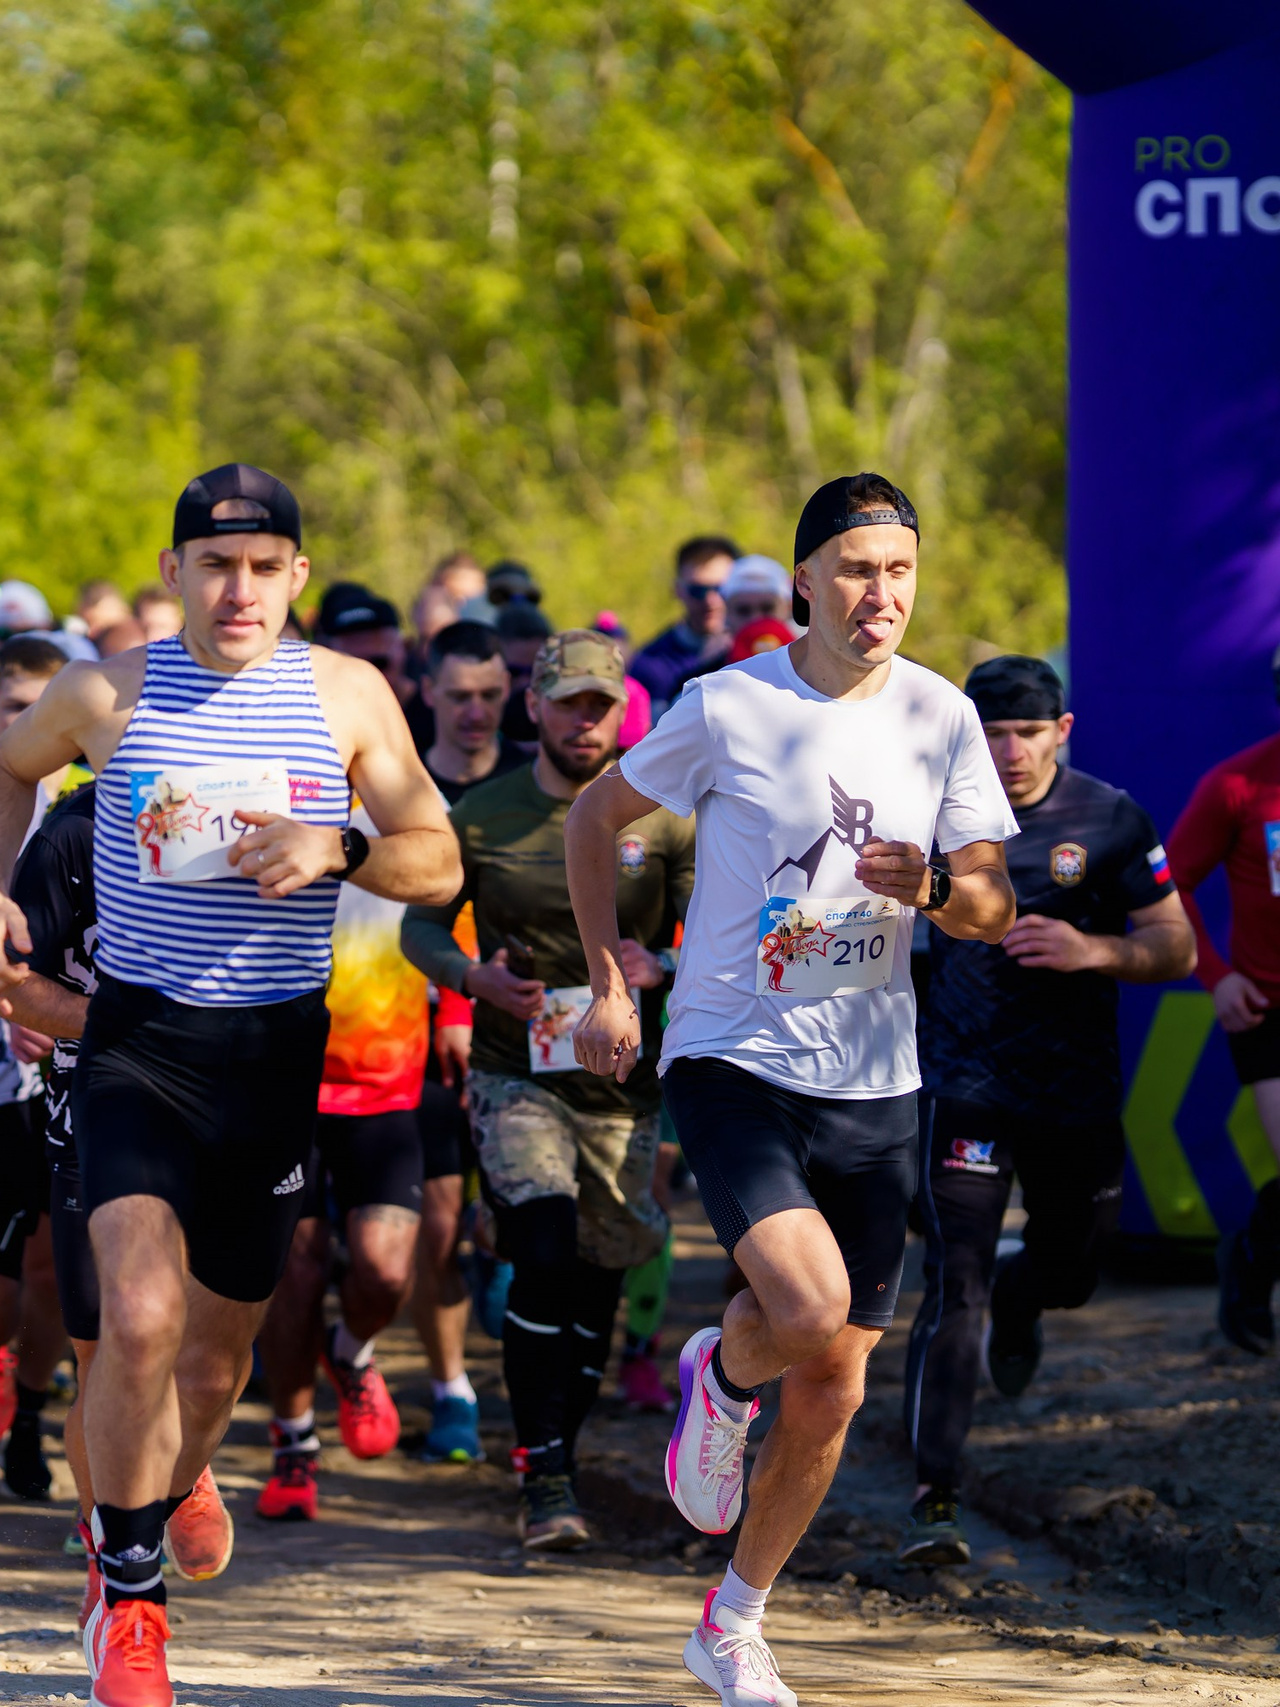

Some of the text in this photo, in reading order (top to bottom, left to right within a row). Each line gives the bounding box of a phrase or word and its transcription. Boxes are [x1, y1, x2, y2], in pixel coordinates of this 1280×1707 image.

[1135, 135, 1231, 171] PRO
[825, 910, 873, 921] СПОРТ 40
[833, 934, 885, 966] 210
